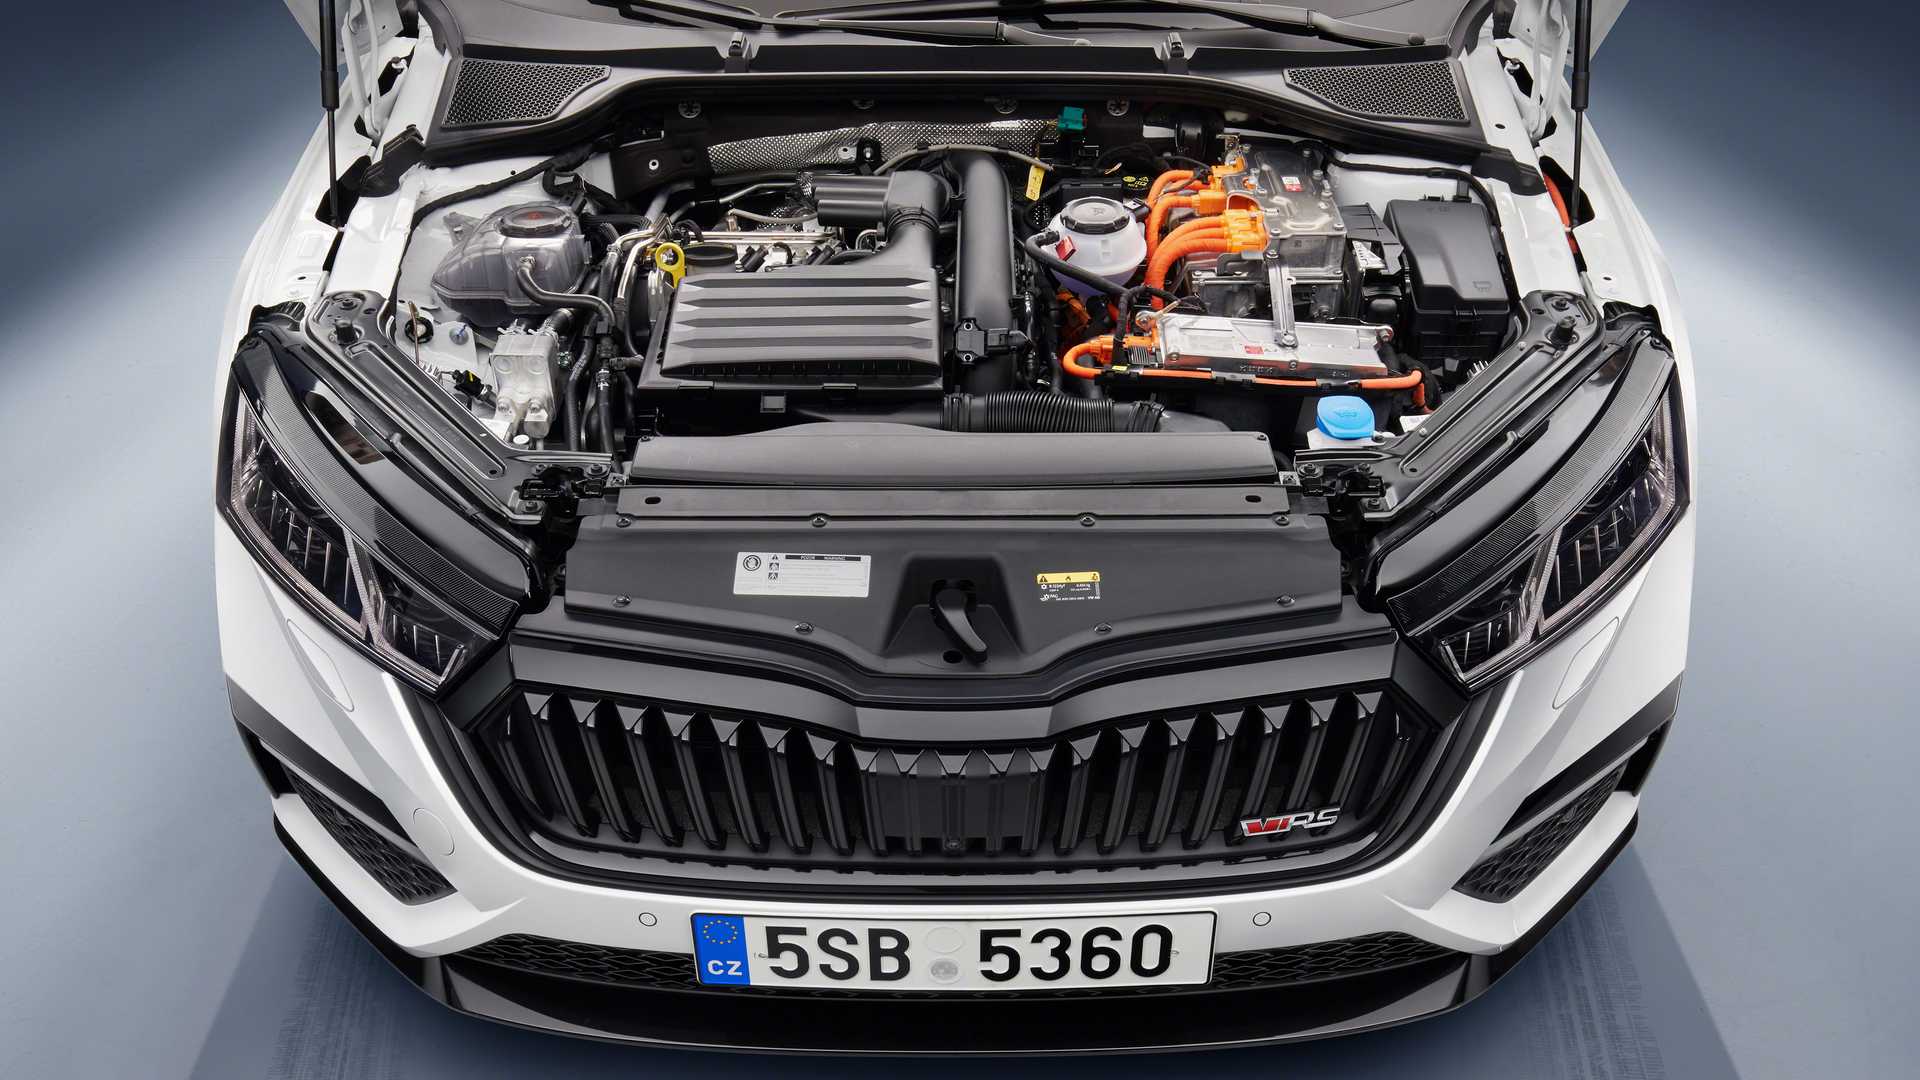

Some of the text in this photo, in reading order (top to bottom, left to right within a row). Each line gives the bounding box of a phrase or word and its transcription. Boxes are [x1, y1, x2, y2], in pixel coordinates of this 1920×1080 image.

[707, 959, 743, 976] CZ
[765, 924, 1173, 982] 5SB 5360
